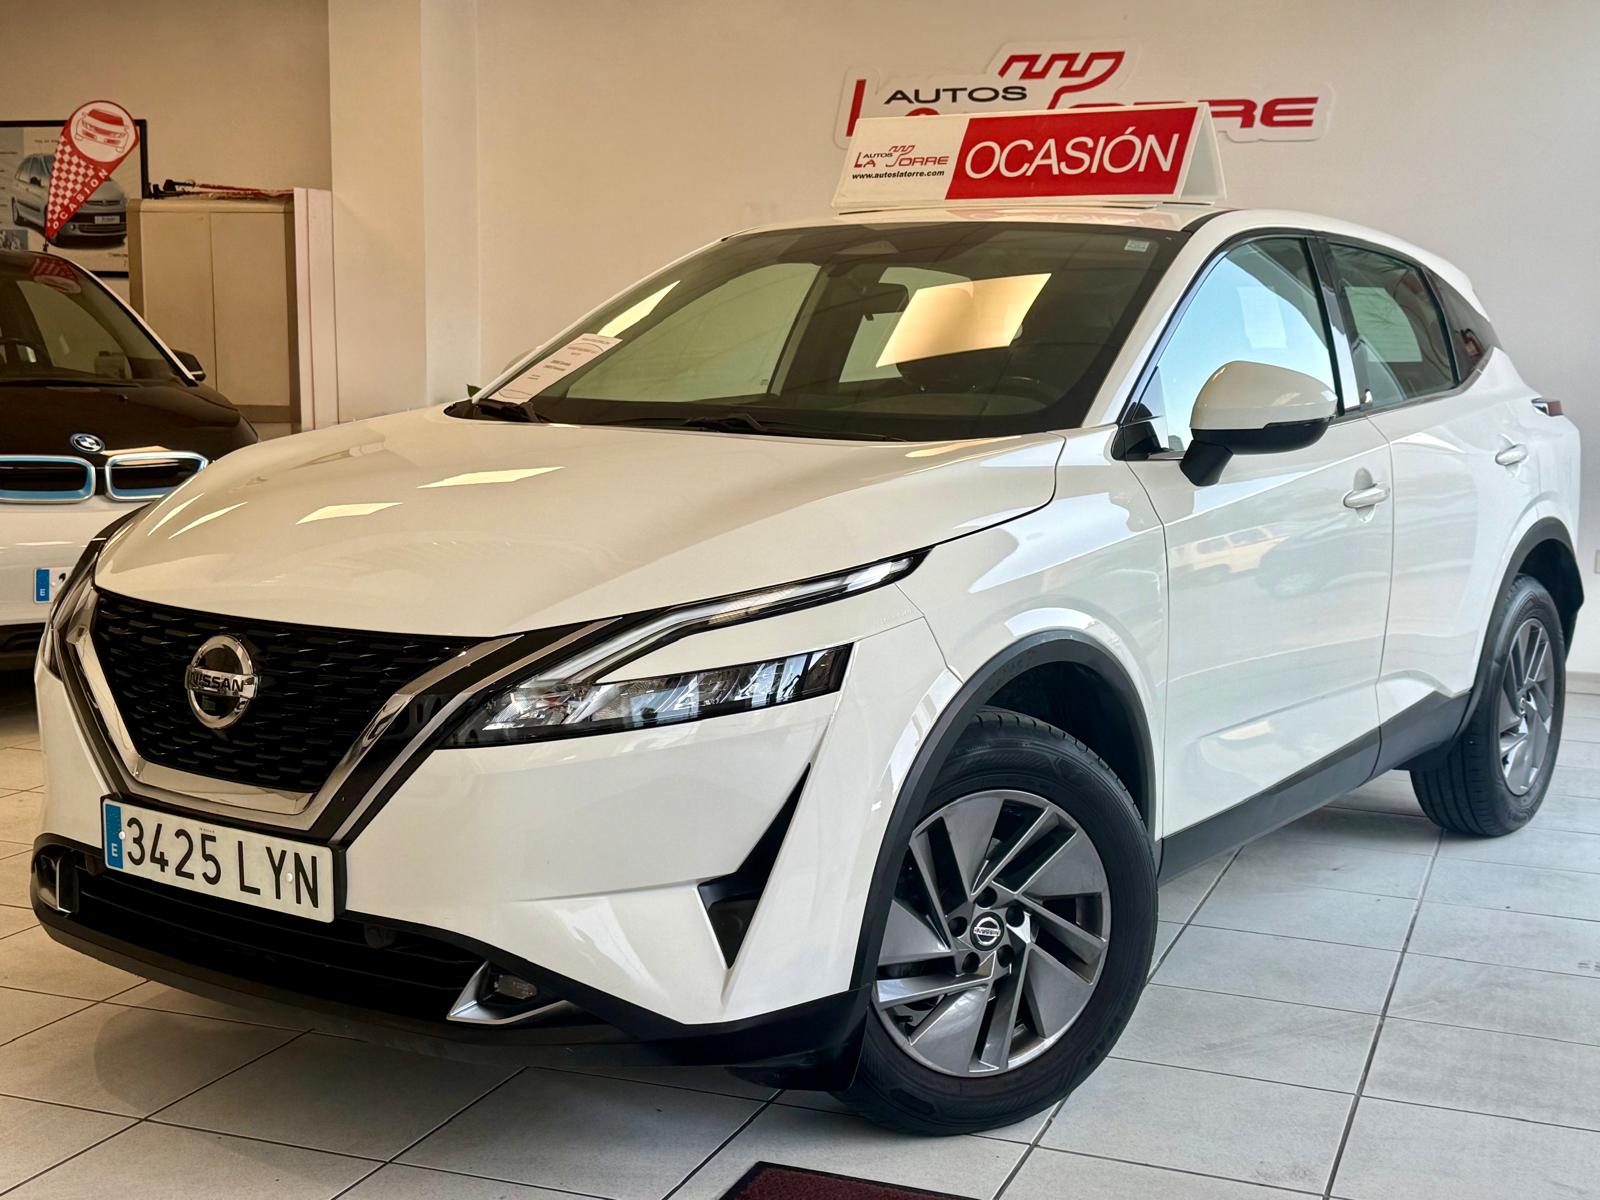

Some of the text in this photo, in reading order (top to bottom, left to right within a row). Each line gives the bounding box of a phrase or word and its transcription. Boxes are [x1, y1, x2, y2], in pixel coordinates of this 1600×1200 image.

[883, 86, 1028, 105] AUTOS
[854, 152, 876, 168] LA
[965, 126, 1180, 180] OCASIÓN
[852, 170, 945, 180] www.autoslatorre.com
[40, 588, 46, 596] E
[191, 670, 245, 693] NISSAN
[111, 817, 319, 909] E 3425 LYN
